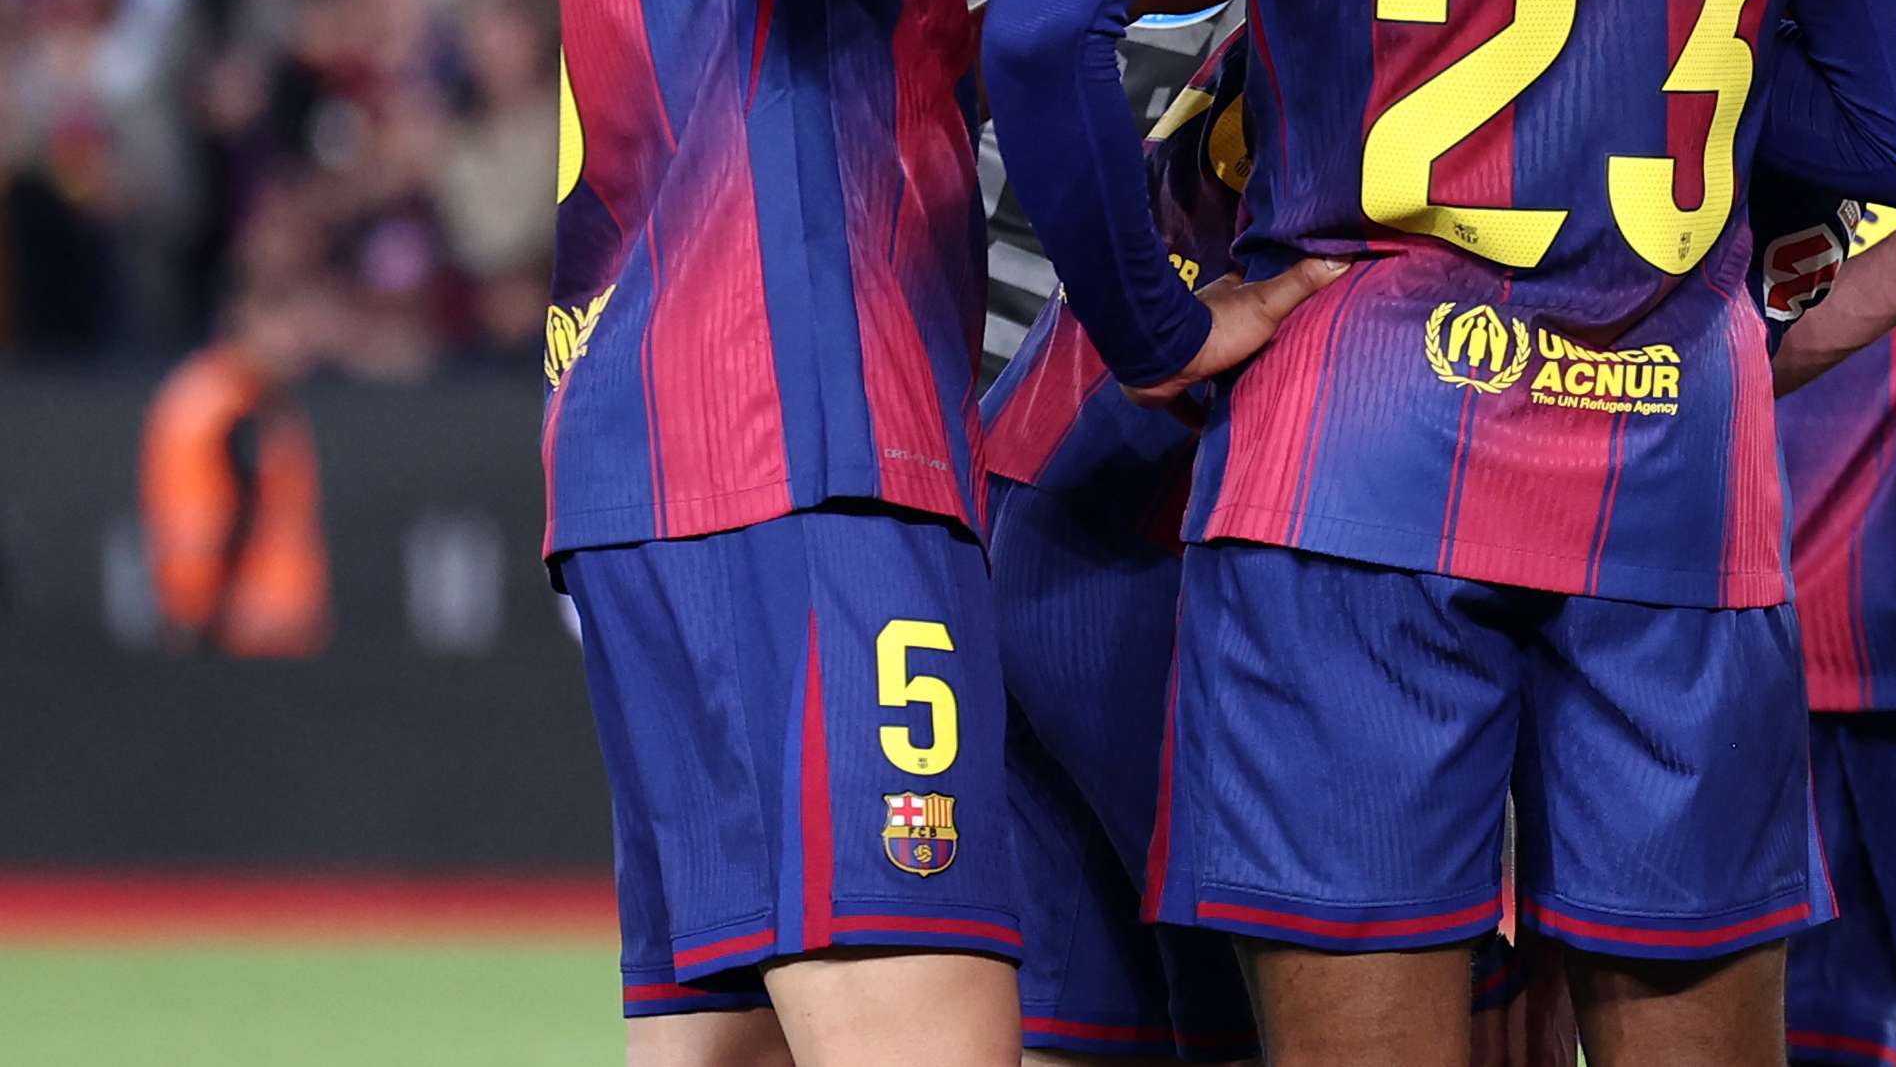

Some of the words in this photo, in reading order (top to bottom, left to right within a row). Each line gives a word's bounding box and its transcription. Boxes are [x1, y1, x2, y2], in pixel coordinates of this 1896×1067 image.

[1538, 328, 1681, 363] UNHCR
[1530, 361, 1681, 399] ACNUR
[1531, 392, 1555, 406] The
[1557, 395, 1578, 408] UN
[1580, 398, 1632, 413] Refugee
[1633, 401, 1678, 416] Agency
[876, 619, 959, 775] 5
